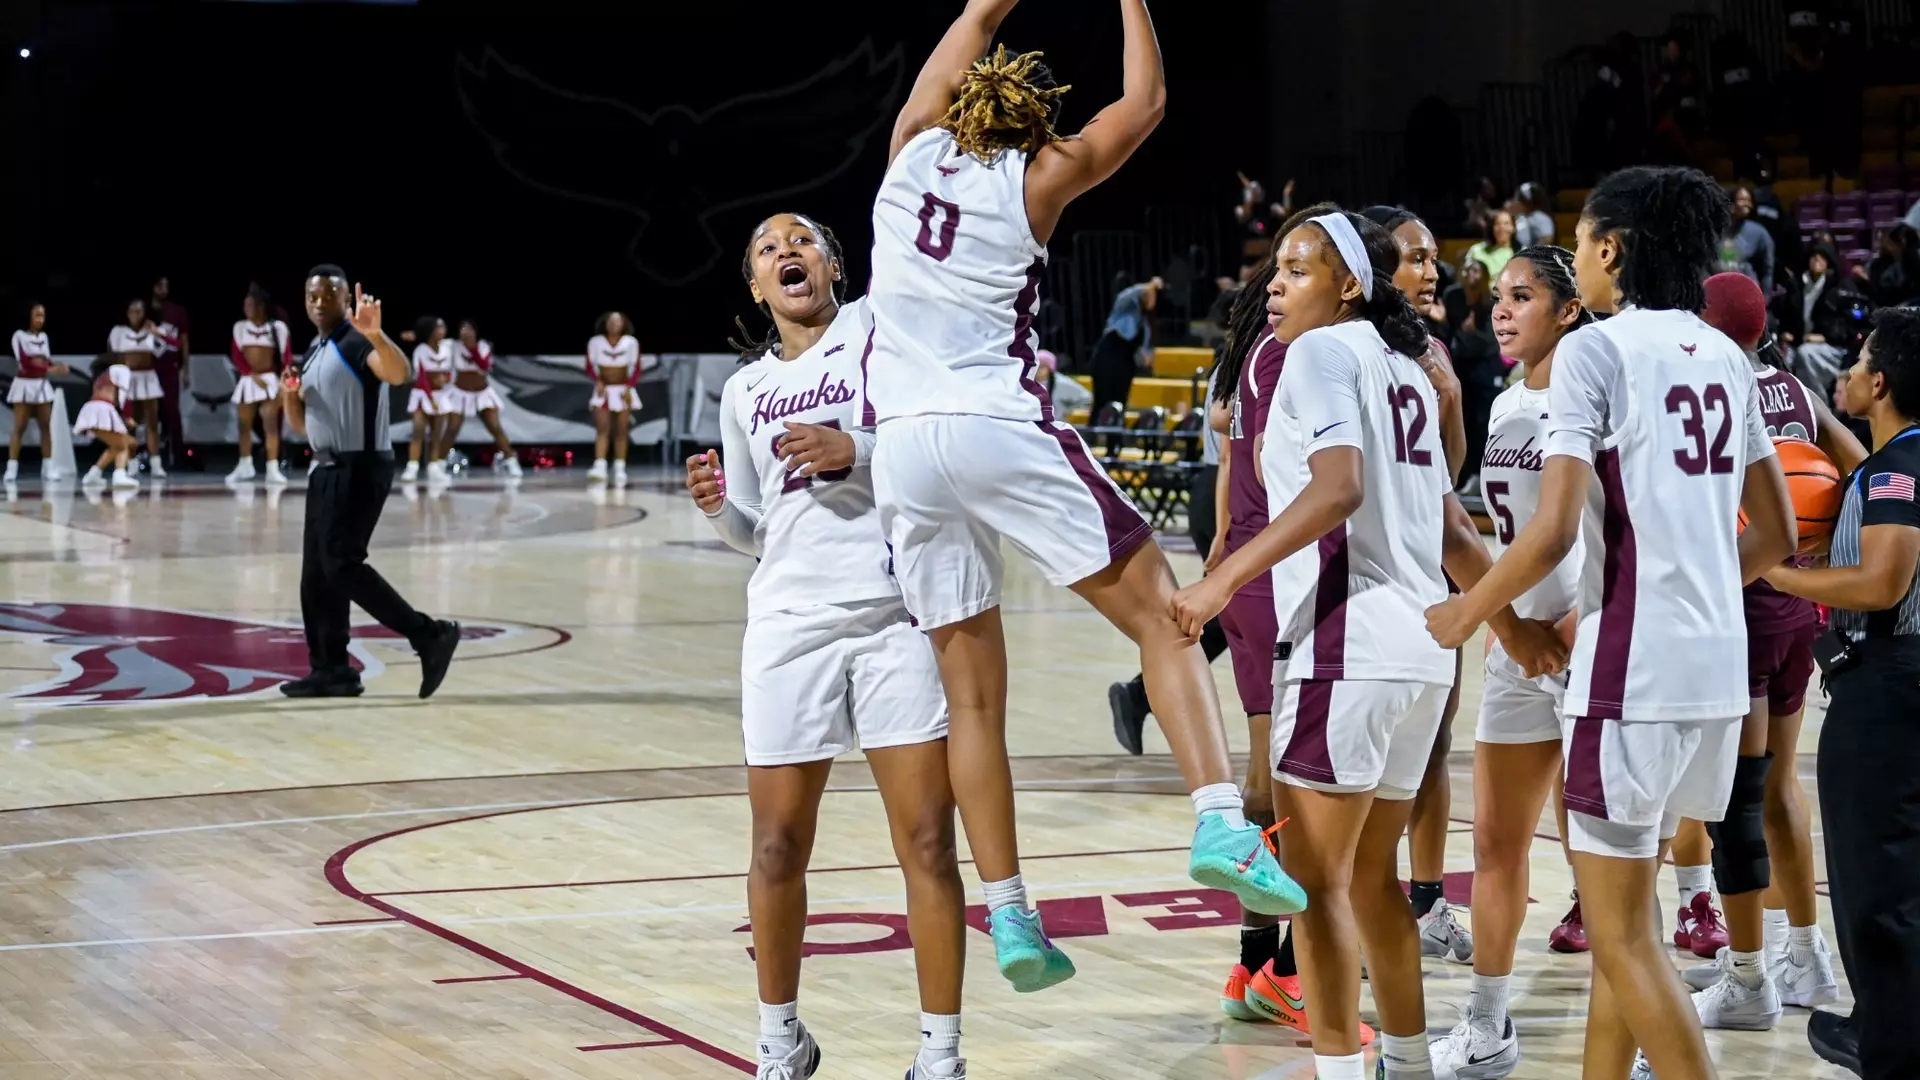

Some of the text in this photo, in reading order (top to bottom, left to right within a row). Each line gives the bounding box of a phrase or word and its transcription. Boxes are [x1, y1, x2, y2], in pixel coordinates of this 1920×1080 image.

[914, 191, 961, 262] 0
[751, 371, 856, 436] Hawks
[1387, 381, 1433, 467] 12
[1665, 382, 1735, 477] 32
[1486, 481, 1515, 545] 5
